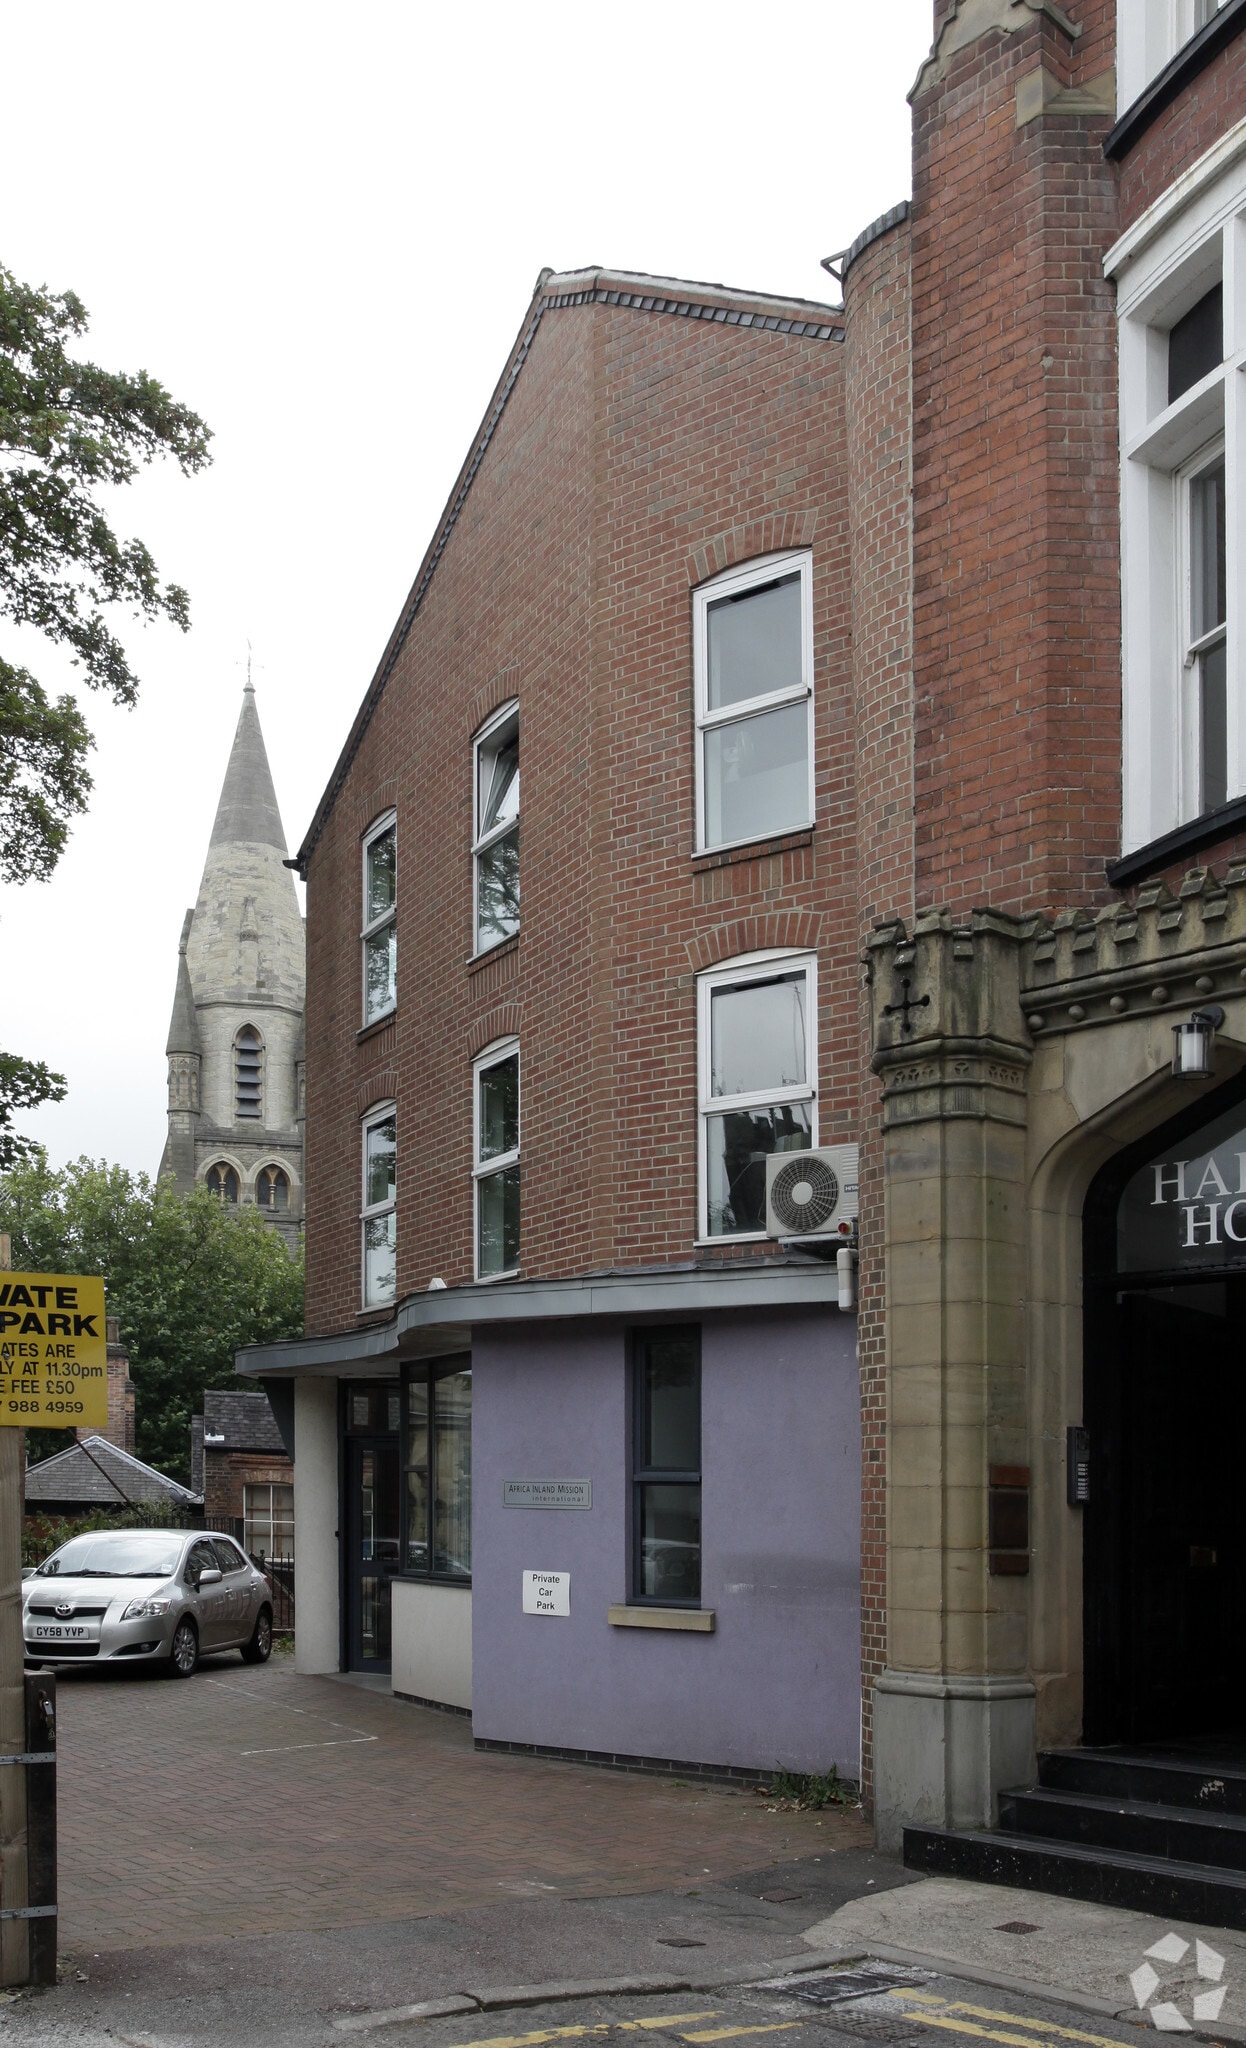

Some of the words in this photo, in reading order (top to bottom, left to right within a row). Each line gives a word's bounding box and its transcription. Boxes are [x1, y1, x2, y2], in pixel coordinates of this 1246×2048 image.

[0, 1311, 99, 1337] PARK
[1, 1342, 39, 1357] ATES
[45, 1344, 76, 1358] ARE
[22, 1361, 39, 1375] AT
[45, 1362, 103, 1379] 11.30pm
[11, 1379, 40, 1394] FEE
[46, 1380, 75, 1394] £50
[8, 1400, 40, 1413] 988
[45, 1401, 84, 1413] 4959
[509, 1485, 531, 1493] AFRICA
[532, 1485, 555, 1494] INLAND
[557, 1485, 584, 1494] MISSION
[532, 1573, 560, 1584] Private
[538, 1587, 553, 1596] Car
[536, 1600, 555, 1610] Park
[36, 1627, 62, 1637] GY58
[64, 1627, 84, 1637] YVP
